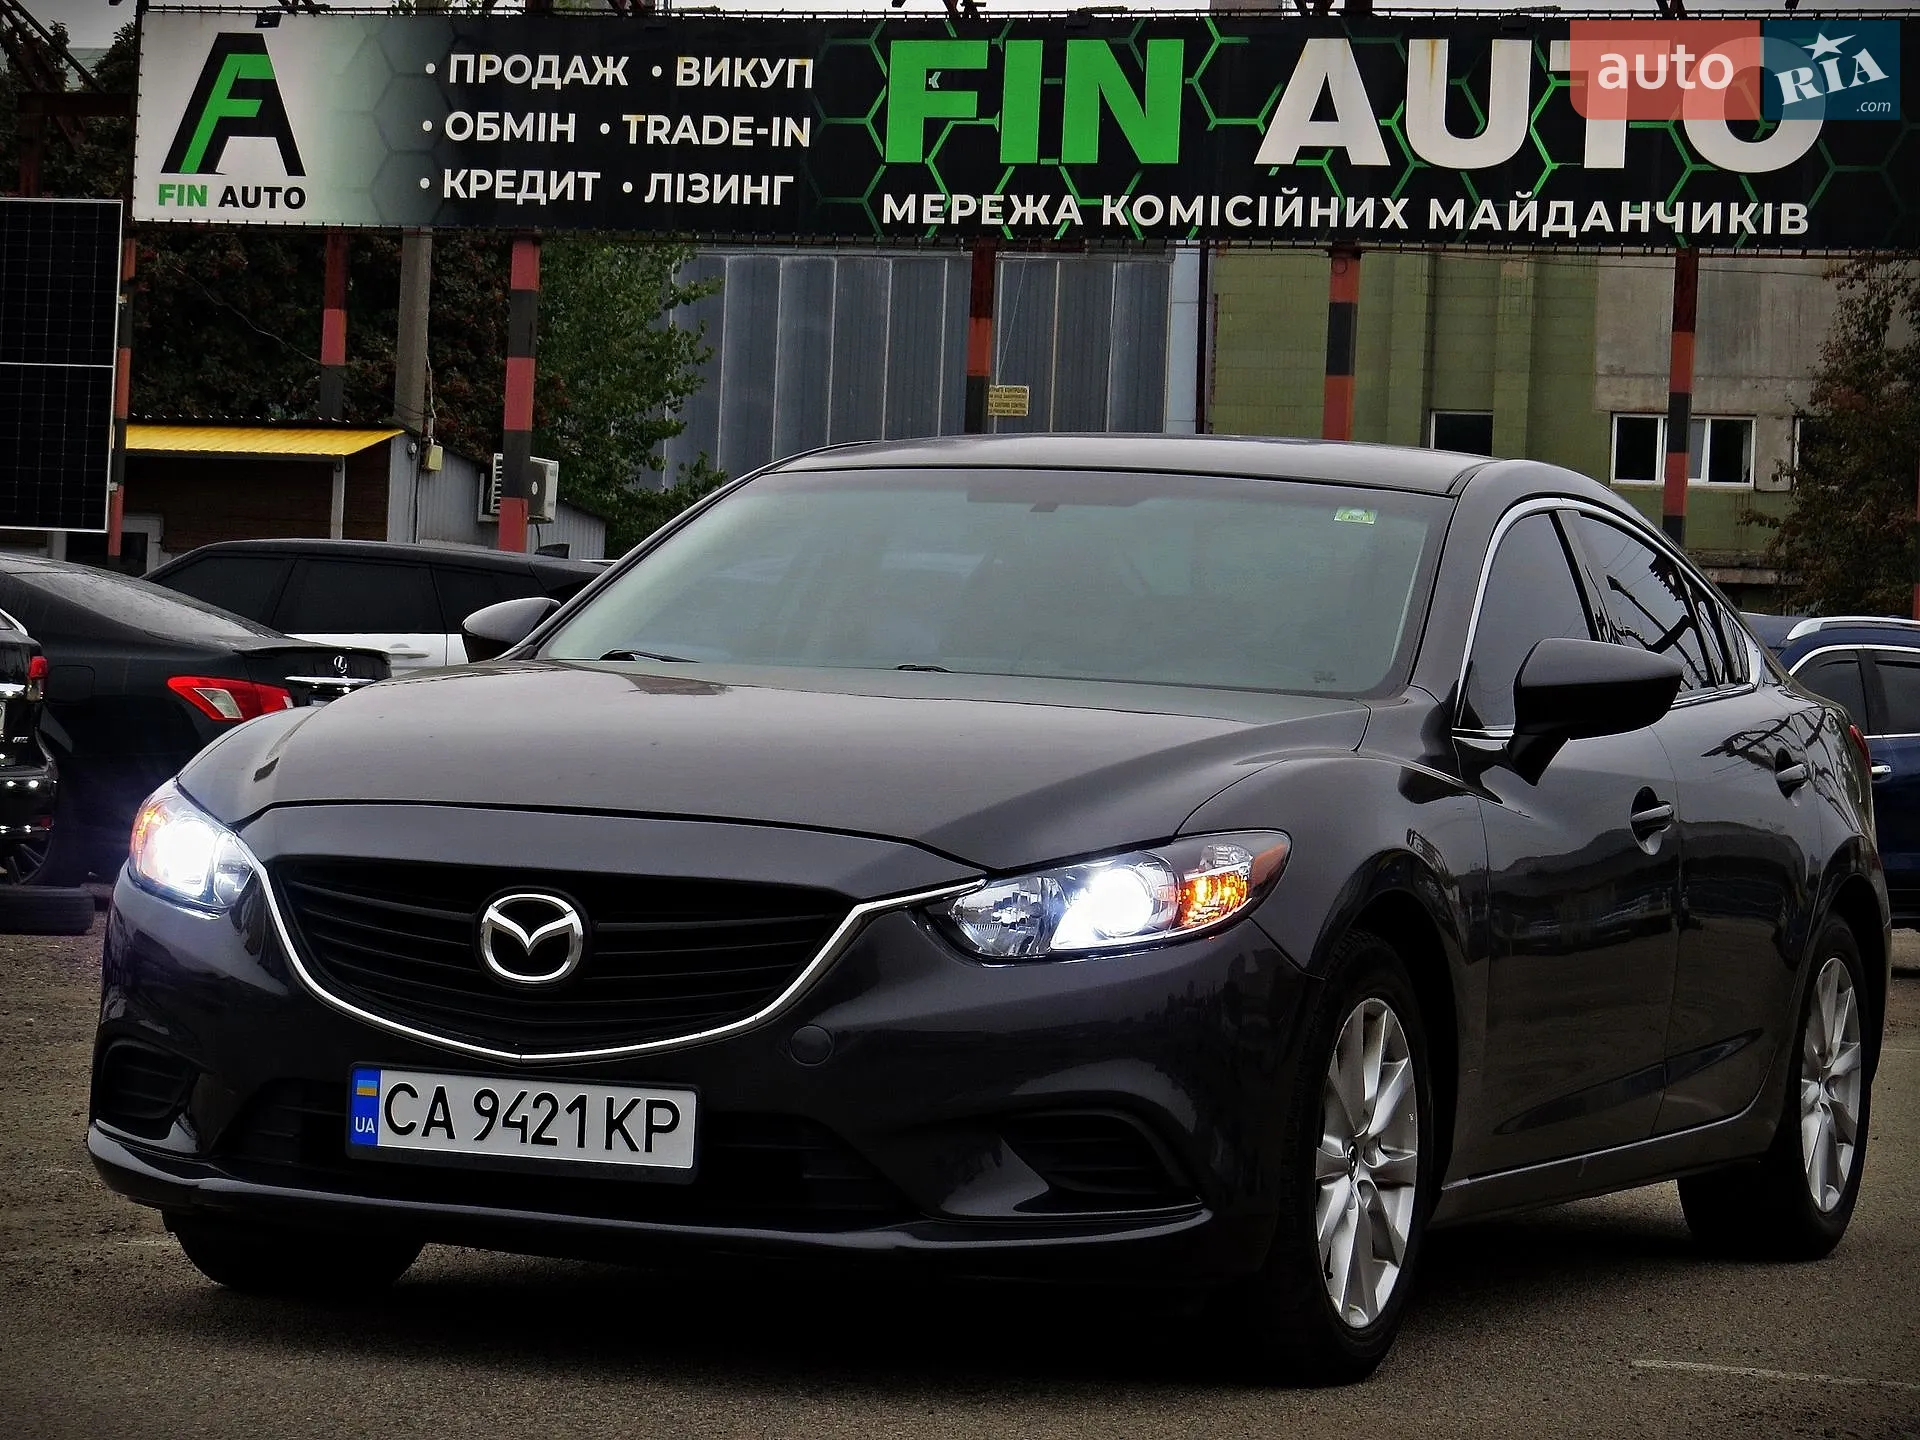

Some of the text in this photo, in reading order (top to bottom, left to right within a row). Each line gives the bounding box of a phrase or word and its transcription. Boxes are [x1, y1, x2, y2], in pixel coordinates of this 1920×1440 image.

[448, 54, 814, 90] ПРОДАЖ ВИКУП
[885, 36, 1825, 173] FIN AUTO
[445, 110, 576, 143] ОБМІН
[622, 114, 811, 147] TRADE-IN
[158, 184, 306, 209] FIN AUTO
[443, 168, 794, 206] КРЕДИТ ЛІЗИНГ
[882, 187, 1809, 238] МЕРЕЖА КОМІСІЙНИХ МАЙДАНЧИКІВ
[355, 1116, 376, 1134] UA
[384, 1082, 681, 1153] CA 9421 KP
